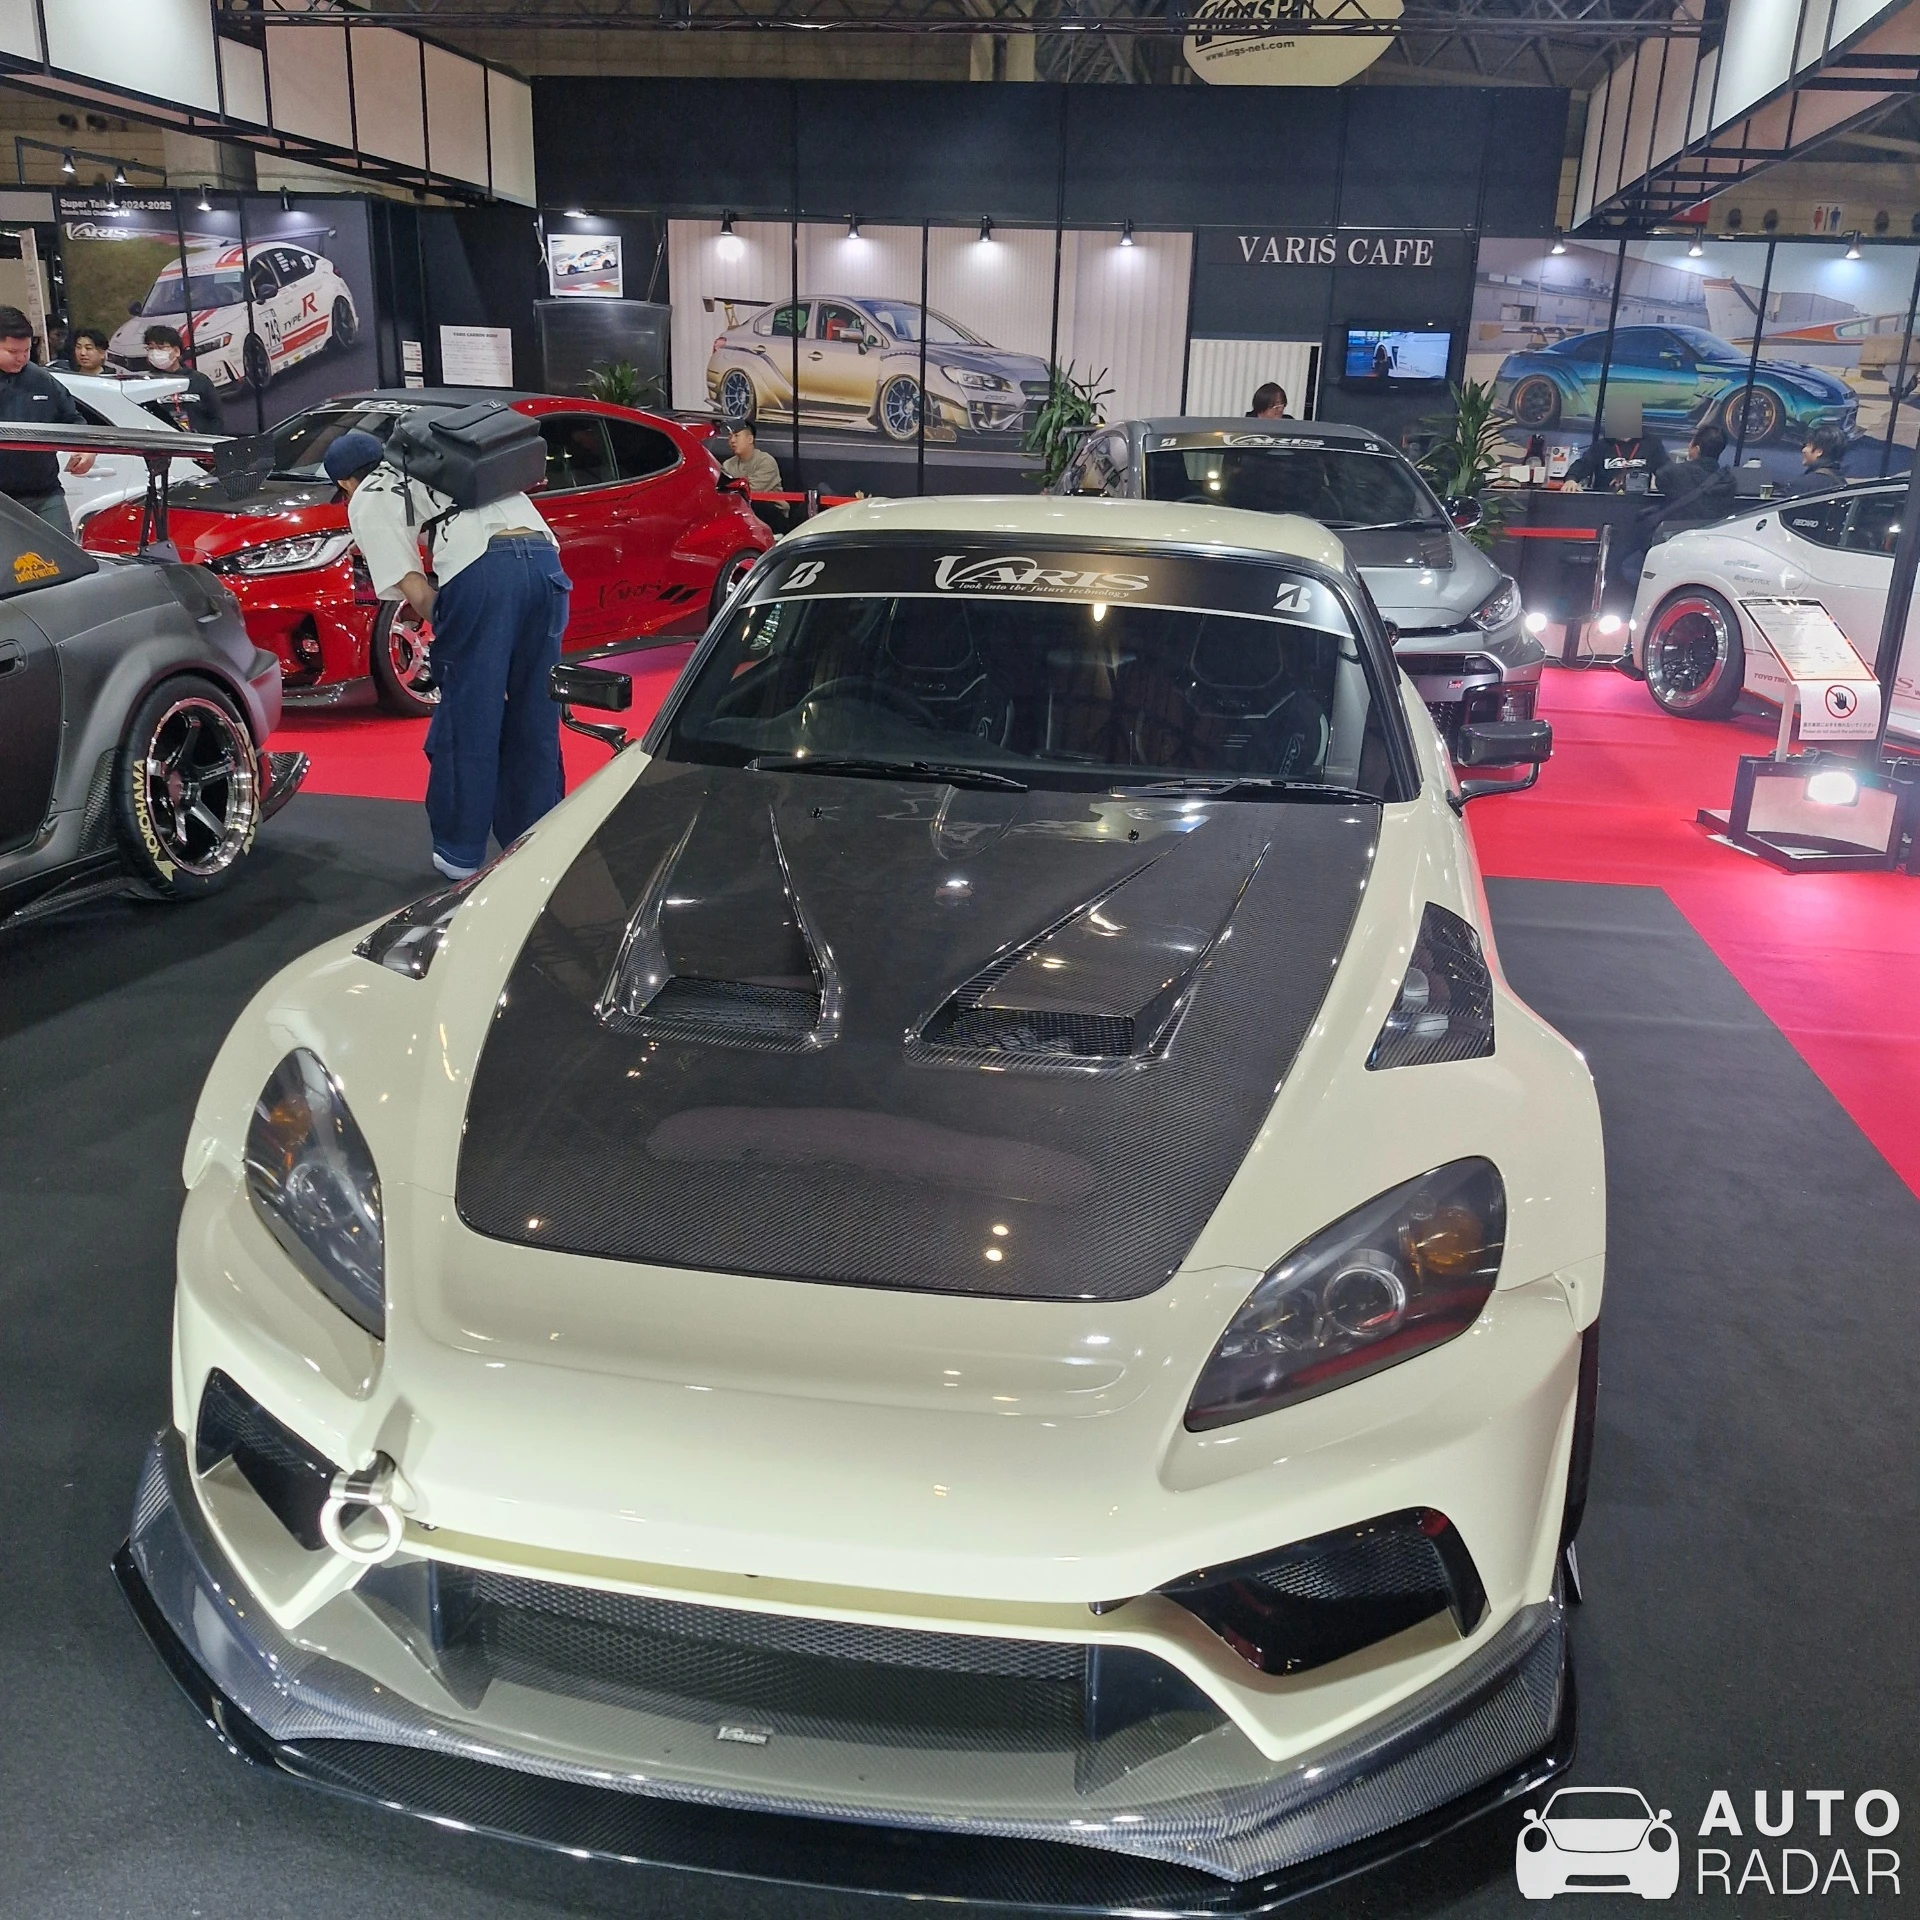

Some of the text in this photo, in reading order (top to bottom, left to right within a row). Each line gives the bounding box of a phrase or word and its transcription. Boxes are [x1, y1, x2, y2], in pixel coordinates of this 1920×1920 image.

[1206, 41, 1295, 61] www.ings-net.com
[60, 198, 88, 209] Super
[121, 201, 172, 210] 2024-2025
[65, 222, 129, 241] VARIS
[1237, 236, 1434, 266] VARIS CAFE
[283, 292, 318, 331] TYPE R
[933, 555, 1150, 591] VARIS
[1027, 585, 1066, 593] future
[1068, 587, 1130, 599] technology
[1754, 672, 1773, 681] TOYO
[132, 759, 161, 860] YOKOHAMA
